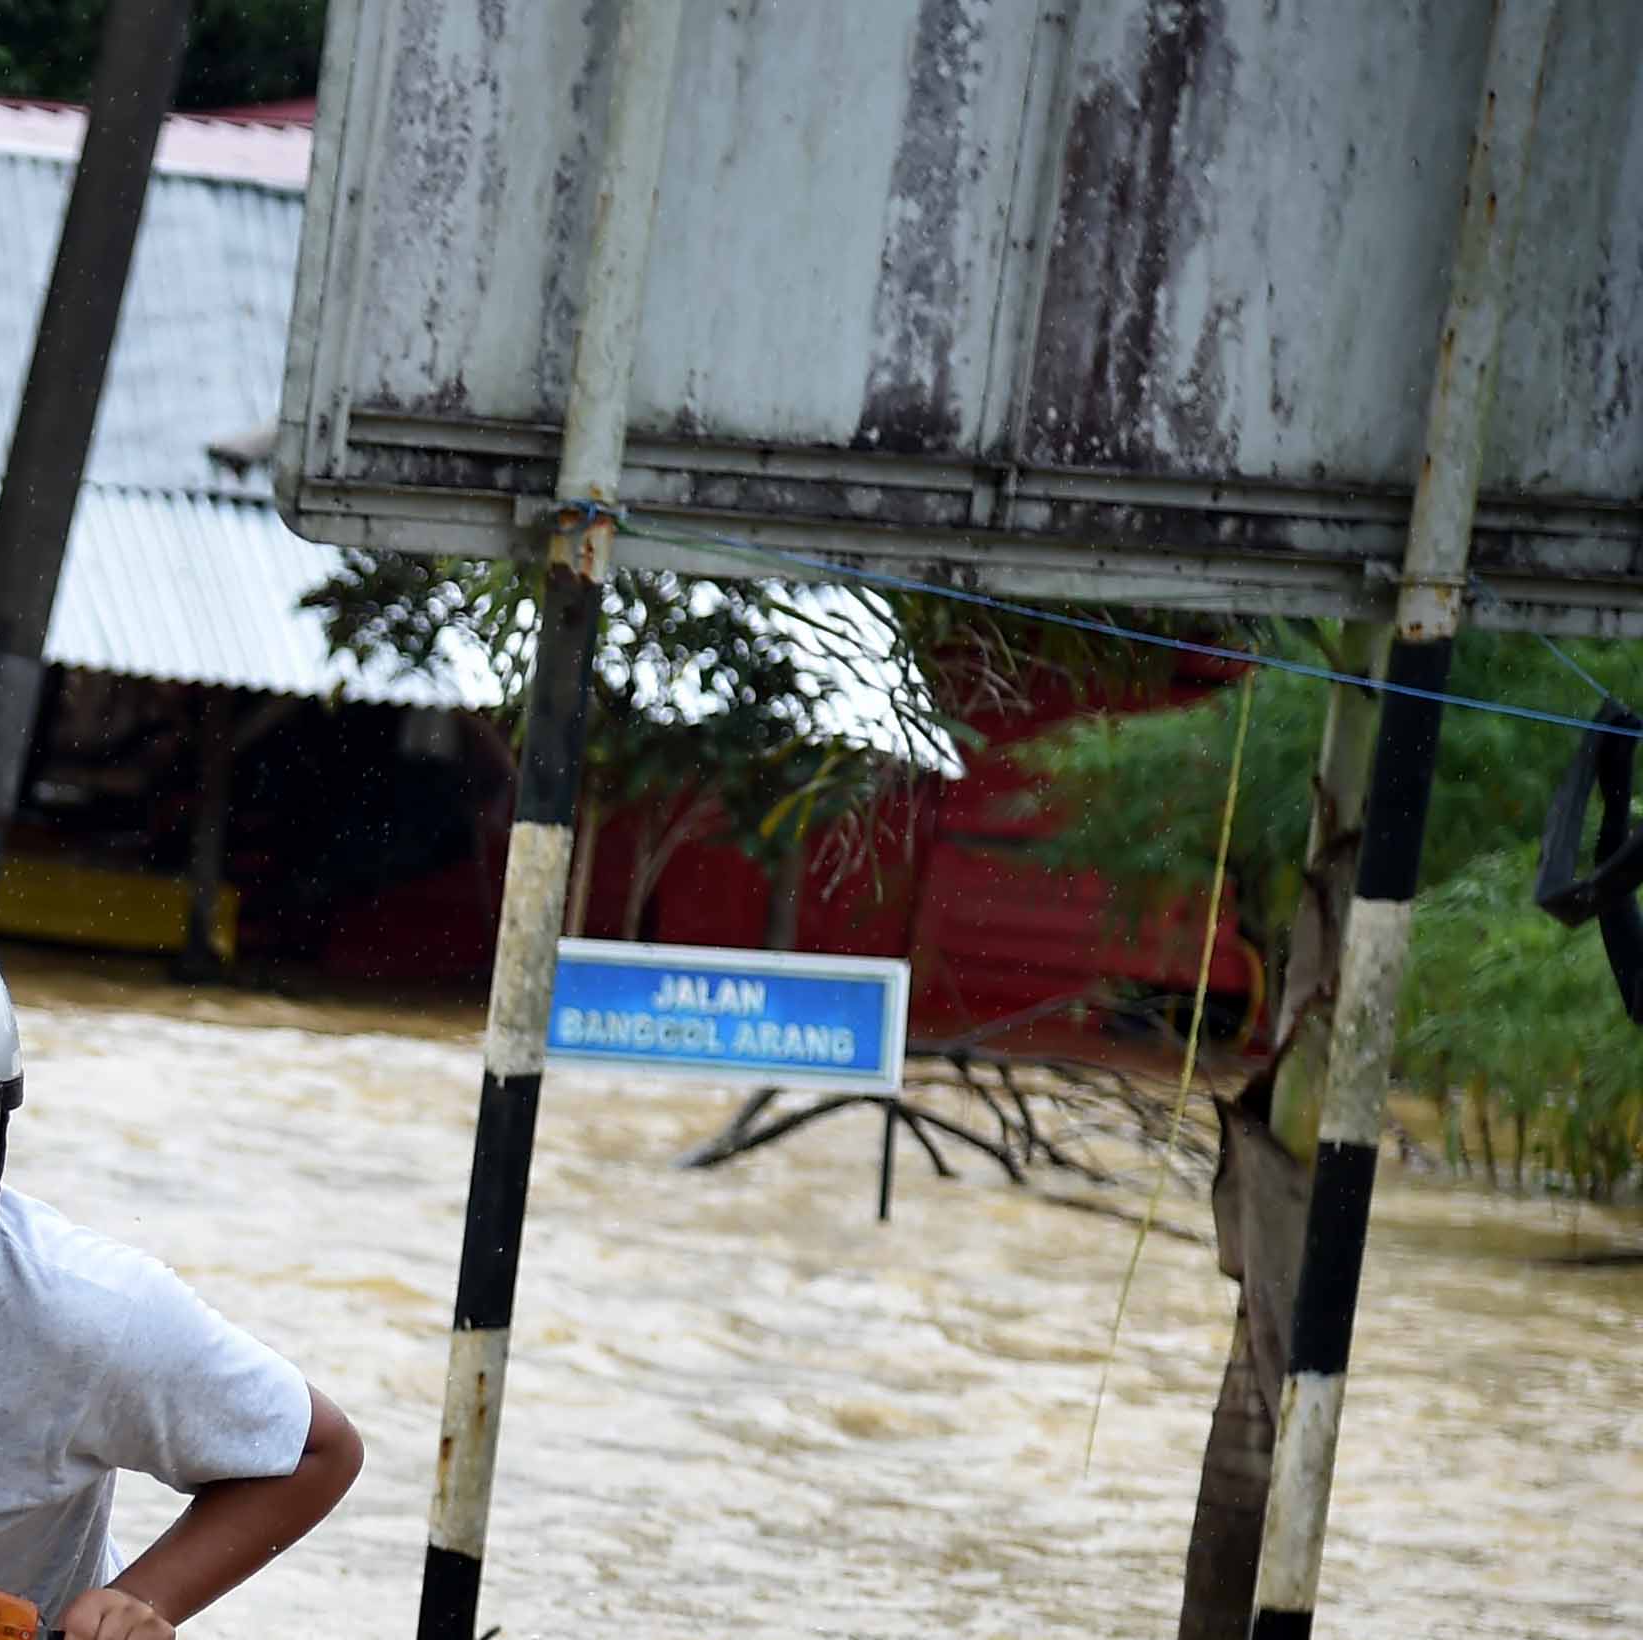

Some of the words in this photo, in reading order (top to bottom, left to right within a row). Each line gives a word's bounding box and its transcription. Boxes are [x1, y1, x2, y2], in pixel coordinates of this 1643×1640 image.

[653, 975, 767, 1015] JALAN
[558, 1007, 724, 1053] BANGGOL
[732, 1020, 855, 1063] ARANG
